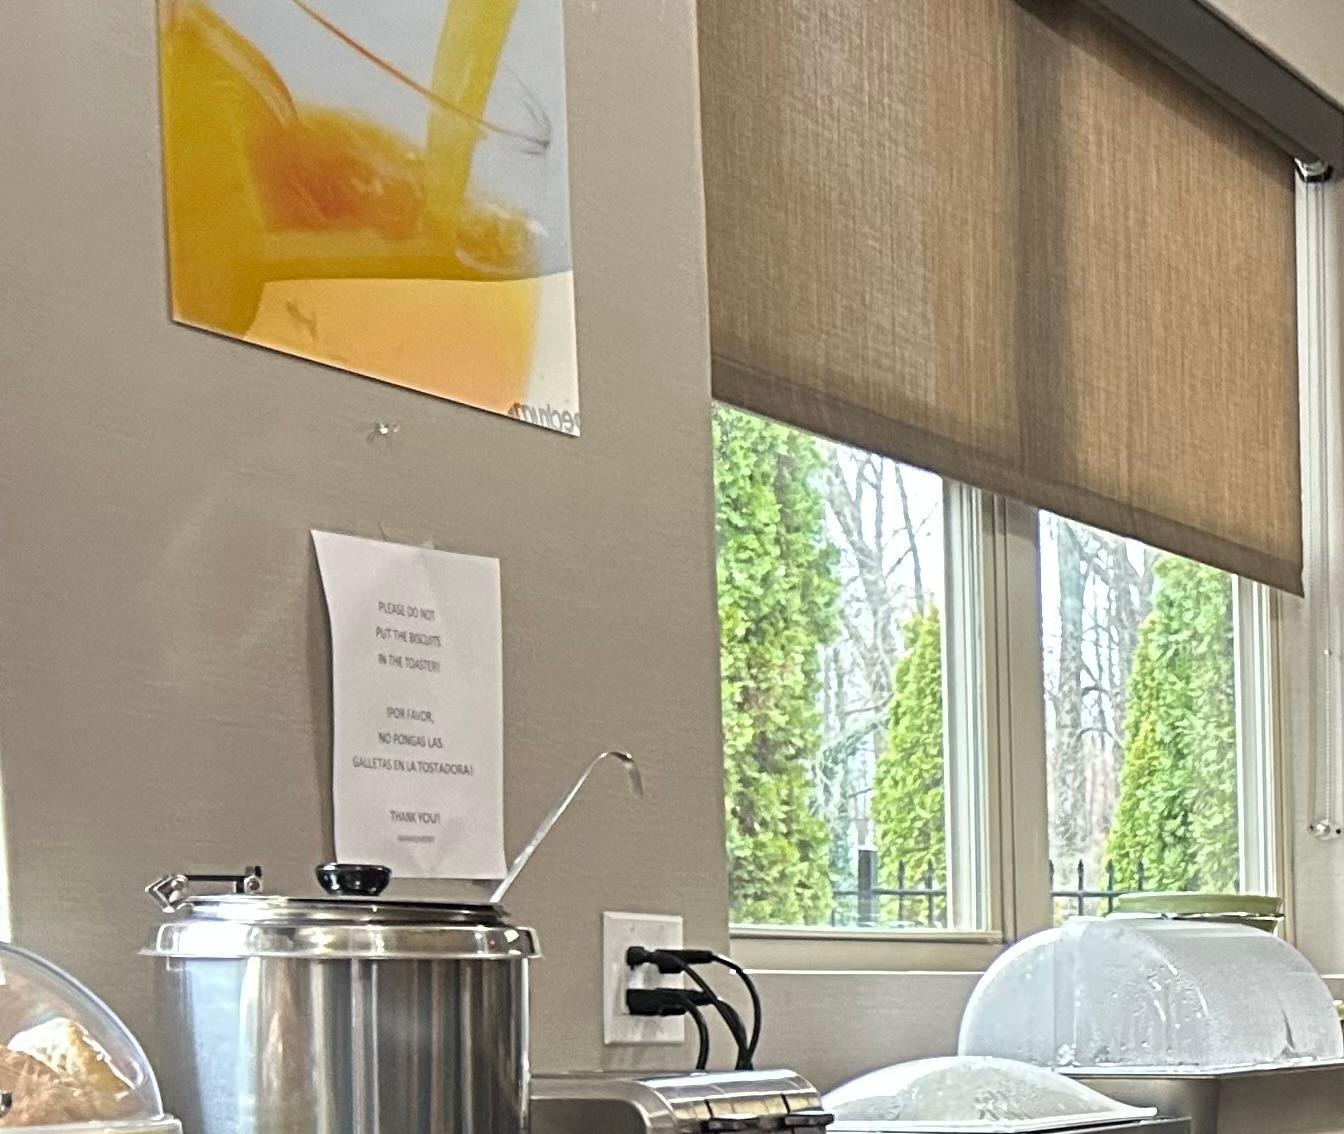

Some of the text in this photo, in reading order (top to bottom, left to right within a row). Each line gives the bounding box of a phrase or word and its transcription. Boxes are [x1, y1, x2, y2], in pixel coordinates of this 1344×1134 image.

[378, 601, 436, 621] PLEASE DO NOT
[376, 626, 391, 639] PUT
[392, 629, 408, 642] THE
[378, 653, 387, 664] IN
[388, 655, 402, 668] THE
[378, 732, 391, 744] NO
[427, 736, 443, 748] LAS
[352, 756, 392, 770] GALLETAS
[394, 759, 405, 771] EN
[406, 761, 416, 772] LA
